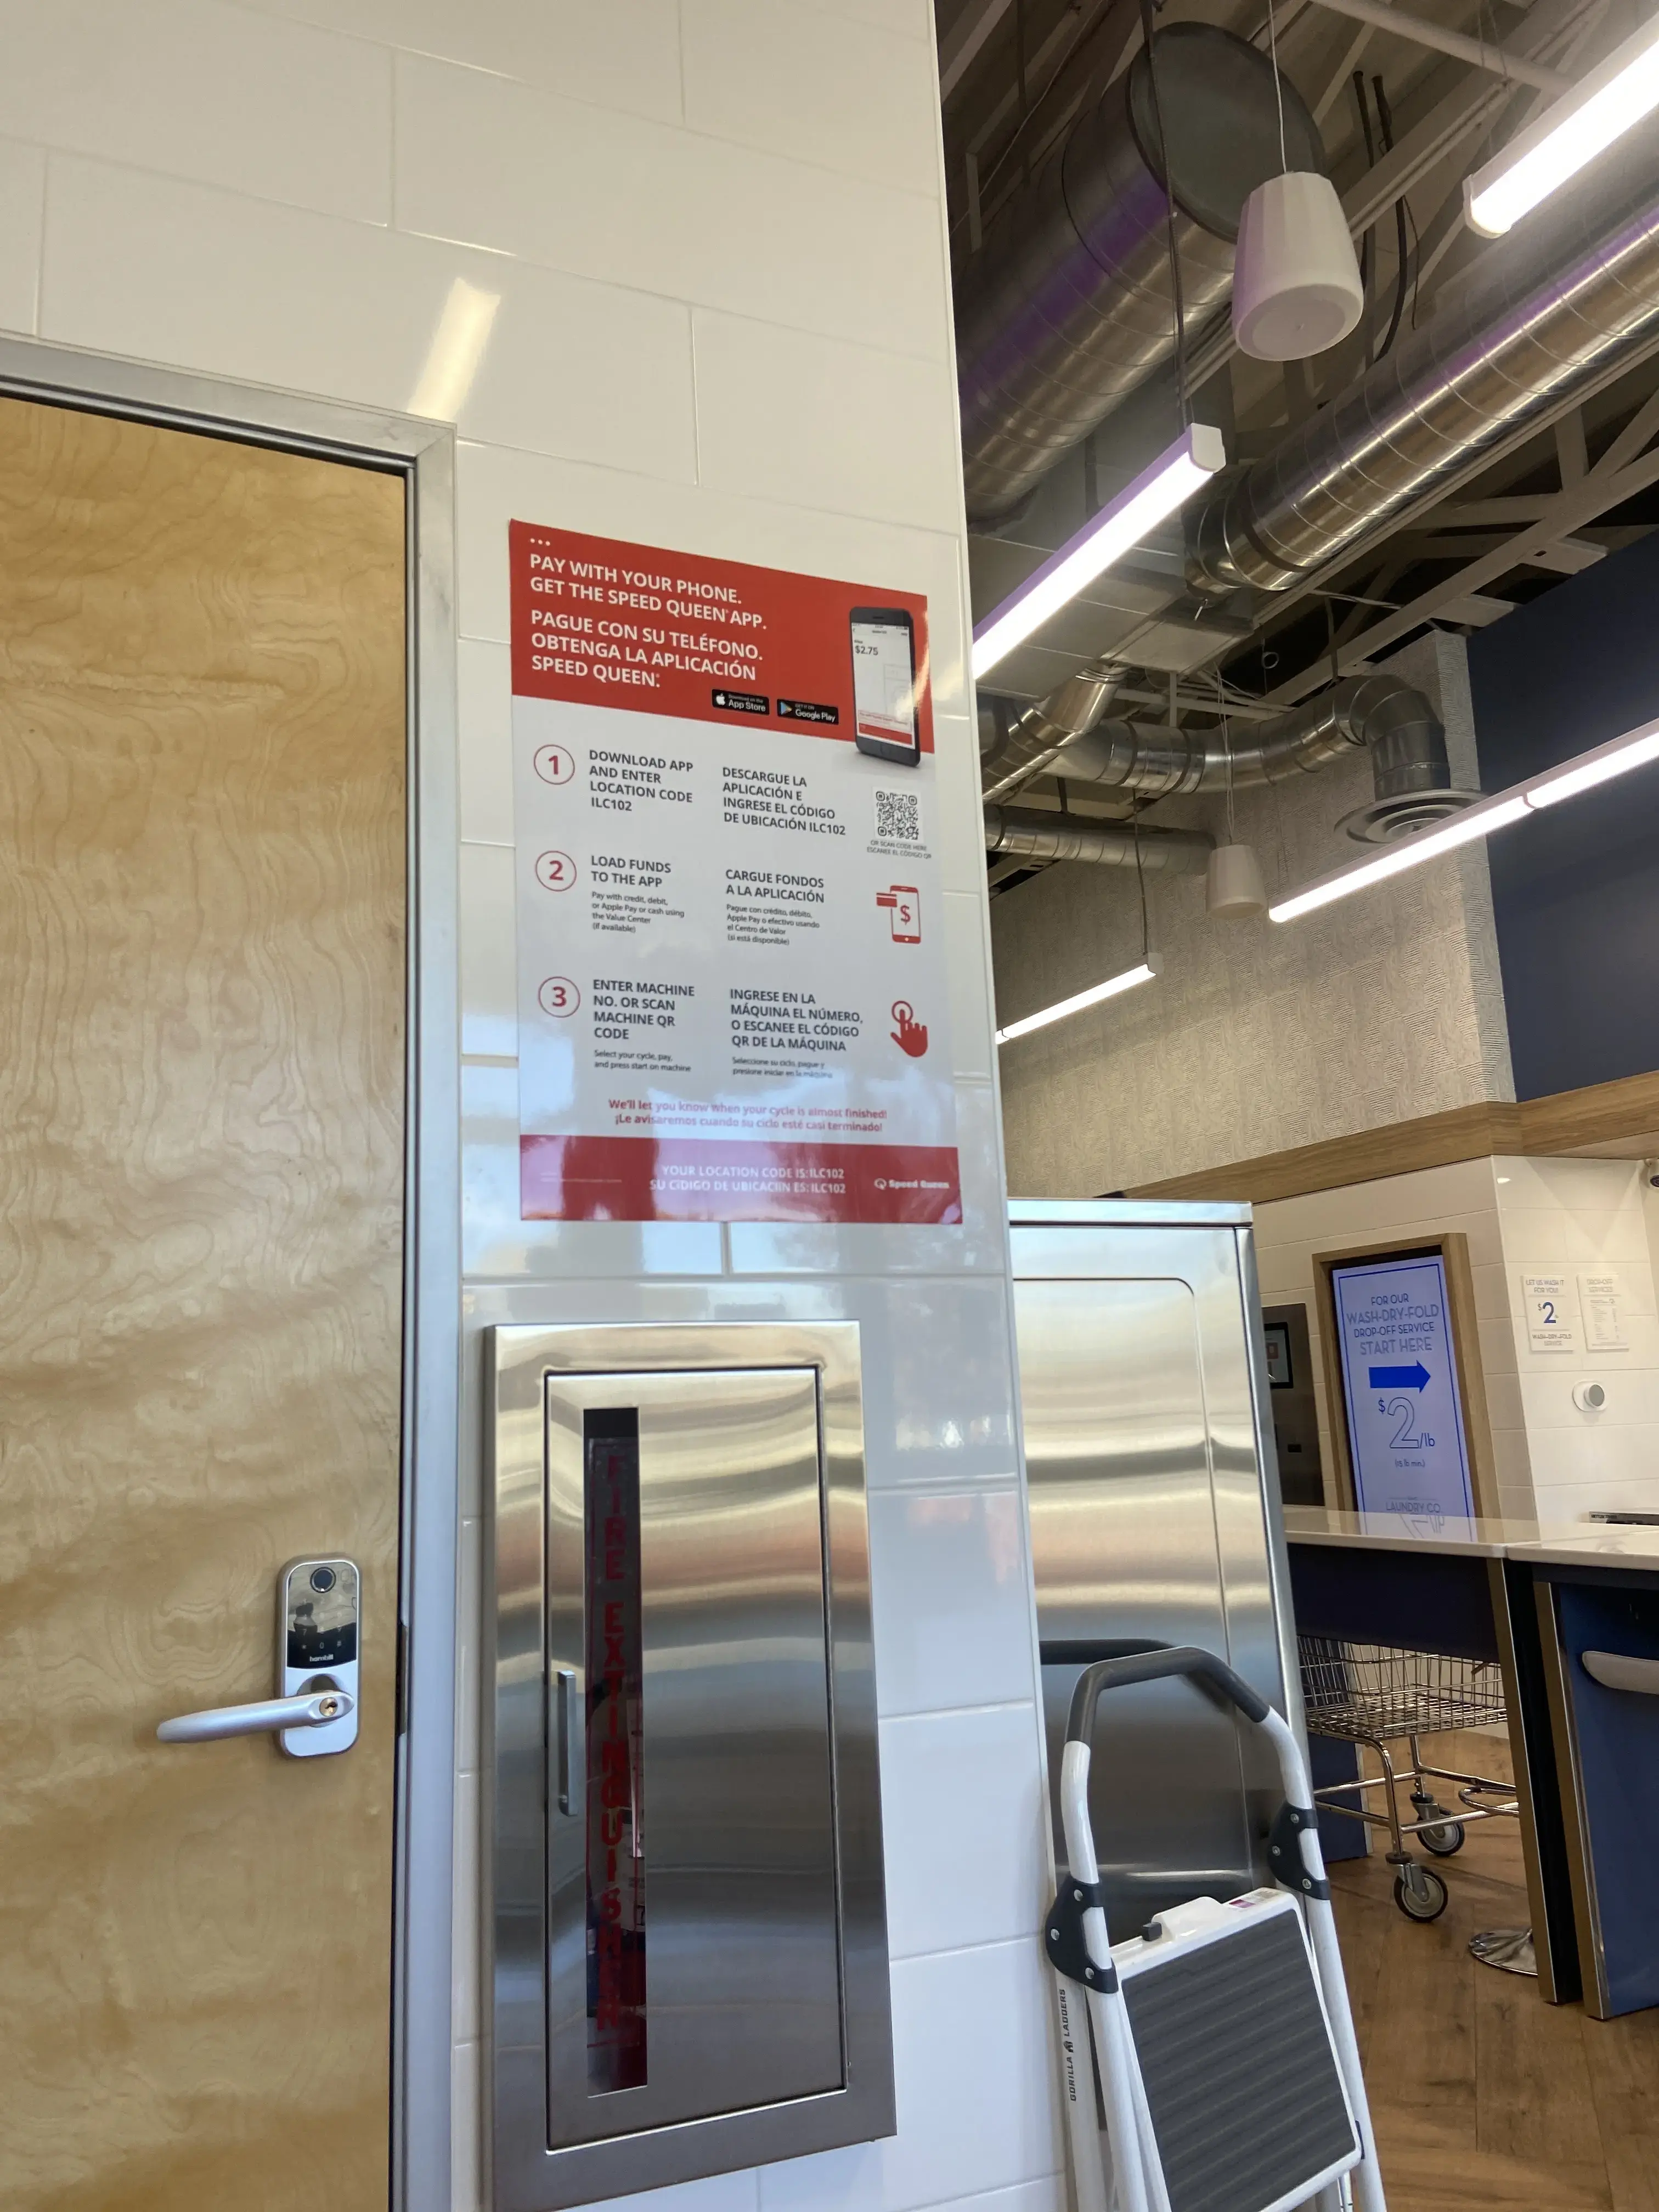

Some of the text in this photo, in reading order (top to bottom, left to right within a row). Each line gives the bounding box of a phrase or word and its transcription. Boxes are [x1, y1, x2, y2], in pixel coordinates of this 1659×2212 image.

[531, 554, 742, 604] PAY WITH YOUR PHONE.
[531, 577, 565, 595] GET
[569, 583, 603, 602] THE
[608, 589, 662, 611] SPEED
[730, 611, 767, 630] APP.
[532, 610, 763, 661] PAGUE CON SU TELÉFONO.
[532, 633, 755, 681] OBTENGA LA APLICACIÓN
[855, 645, 878, 656] $2.75
[532, 655, 588, 676] SPEED
[728, 699, 766, 712] App Store
[795, 708, 836, 723] Google Play
[548, 755, 559, 775] 1
[590, 749, 693, 772] DOWNLOAD APP
[589, 766, 661, 784] AND ENTER
[723, 767, 807, 787] DESCARGUE LA
[590, 781, 693, 803] LOCATION CODE
[723, 782, 802, 801] APLICACIÓN E
[591, 797, 632, 811] ILC102
[724, 797, 835, 819] INGRESE EL CÓDIGO
[724, 812, 846, 836] DE UBICACIÓN ILC102
[549, 860, 564, 881] 2
[591, 855, 672, 873] LOAD FUNDS
[591, 871, 662, 887] TO THE APP
[726, 868, 823, 888] CARGUE FONDOS
[592, 891, 604, 900] Pay
[624, 895, 646, 904] credit,
[648, 896, 668, 905] debit,
[726, 884, 824, 903] A LA APLICACIÓN
[602, 903, 623, 912] Apple
[625, 905, 637, 914] Pay
[666, 910, 685, 918] using
[606, 913, 625, 922] Value
[628, 916, 651, 924] Center
[552, 986, 567, 1007] 3
[593, 979, 695, 997] ENTER MACHINE
[730, 989, 816, 1004] INGRESE EN LA
[594, 995, 675, 1011] NO. OR SCAN
[594, 1012, 675, 1028] MACHINE QR
[731, 1003, 863, 1024] MÁQUINA EL NÚMERO,
[595, 1027, 629, 1040] CODE
[731, 1020, 859, 1037] O ESCANEE EL CÓDIGO
[732, 1036, 847, 1052] QR DE LA MÁQUINA
[595, 1049, 616, 1058] Select
[610, 1062, 629, 1071] press
[661, 1064, 691, 1072] machine
[608, 1098, 635, 1109] We'll
[639, 1101, 652, 1110] let
[656, 1103, 675, 1113] you
[679, 1101, 708, 1112] know
[711, 1102, 740, 1113] when
[743, 1107, 767, 1116] your
[769, 1106, 794, 1117] cycle
[797, 1107, 805, 1116] is
[808, 1107, 843, 1118] almost
[634, 1115, 697, 1125] avisaremos
[700, 1118, 738, 1127] cuando
[756, 1118, 780, 1128] ciclo
[806, 1122, 825, 1130] casi
[662, 1165, 695, 1176] YOUR
[699, 1166, 760, 1178] LOCATION
[761, 1167, 793, 1178] CODE
[650, 1180, 666, 1190] SU
[714, 1182, 728, 1192] DE
[1371, 1293, 1409, 1306] FOR OUR
[1346, 1304, 1439, 1325] WASH-DRY-FOLD
[1353, 1322, 1435, 1338] DROP-OFF SERVICE
[1360, 1336, 1432, 1356] START HERE
[1385, 1500, 1424, 1513] LAUNDRY
[605, 1455, 627, 1581] FIRE
[1059, 1989, 1076, 2102] GORILLA LADDERS
